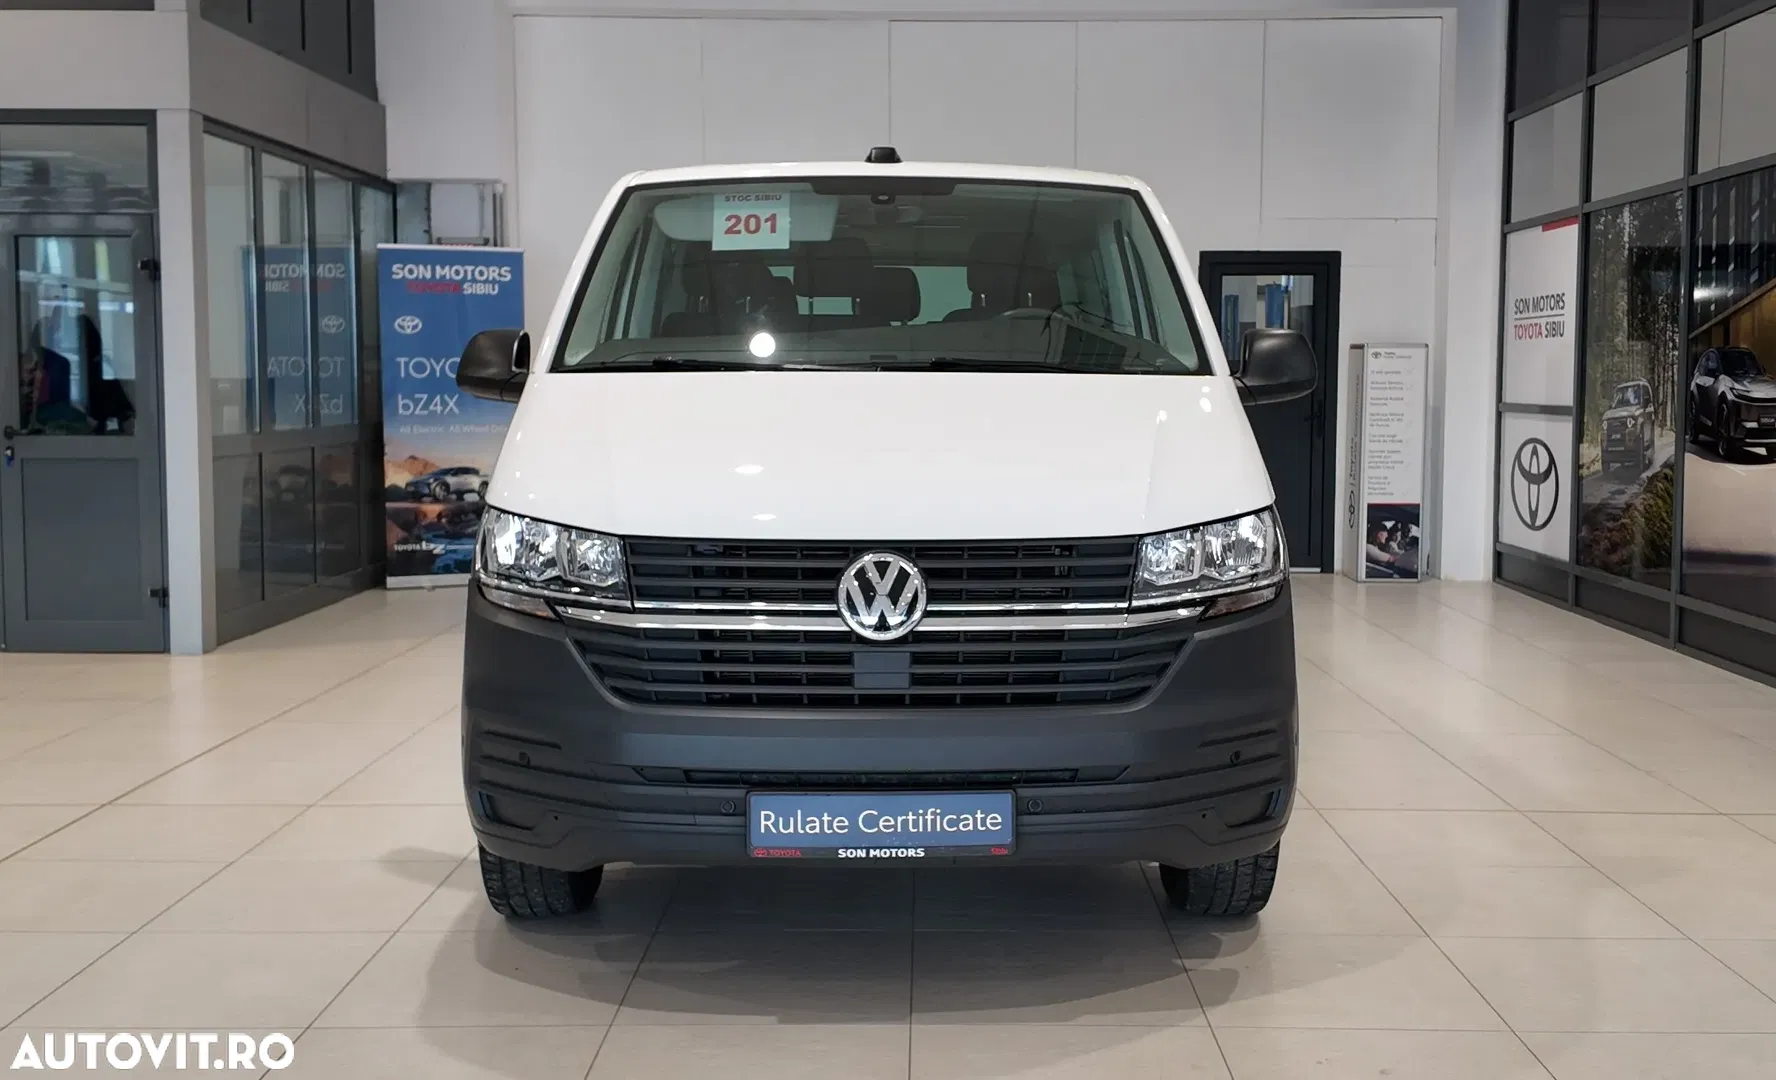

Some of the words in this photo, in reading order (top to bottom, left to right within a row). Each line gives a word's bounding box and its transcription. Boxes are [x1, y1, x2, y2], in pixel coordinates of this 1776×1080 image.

[724, 194, 752, 202] STOC
[754, 193, 782, 201] SIBIU
[723, 213, 777, 235] 201
[391, 264, 432, 280] SON
[435, 265, 512, 282] MOTORS
[463, 283, 499, 295] SIBIU
[1514, 298, 1530, 315] SON
[1532, 292, 1566, 313] MOTORS
[1513, 322, 1543, 340] TOYOTA
[1545, 320, 1565, 338] SIBIU
[396, 357, 460, 379] TOYO
[398, 394, 460, 416] bZ4X
[843, 556, 922, 635] VW
[760, 810, 849, 834] Rulate
[858, 808, 1002, 833] Certificate
[837, 848, 868, 858] SON
[869, 847, 925, 858] MOTORS
